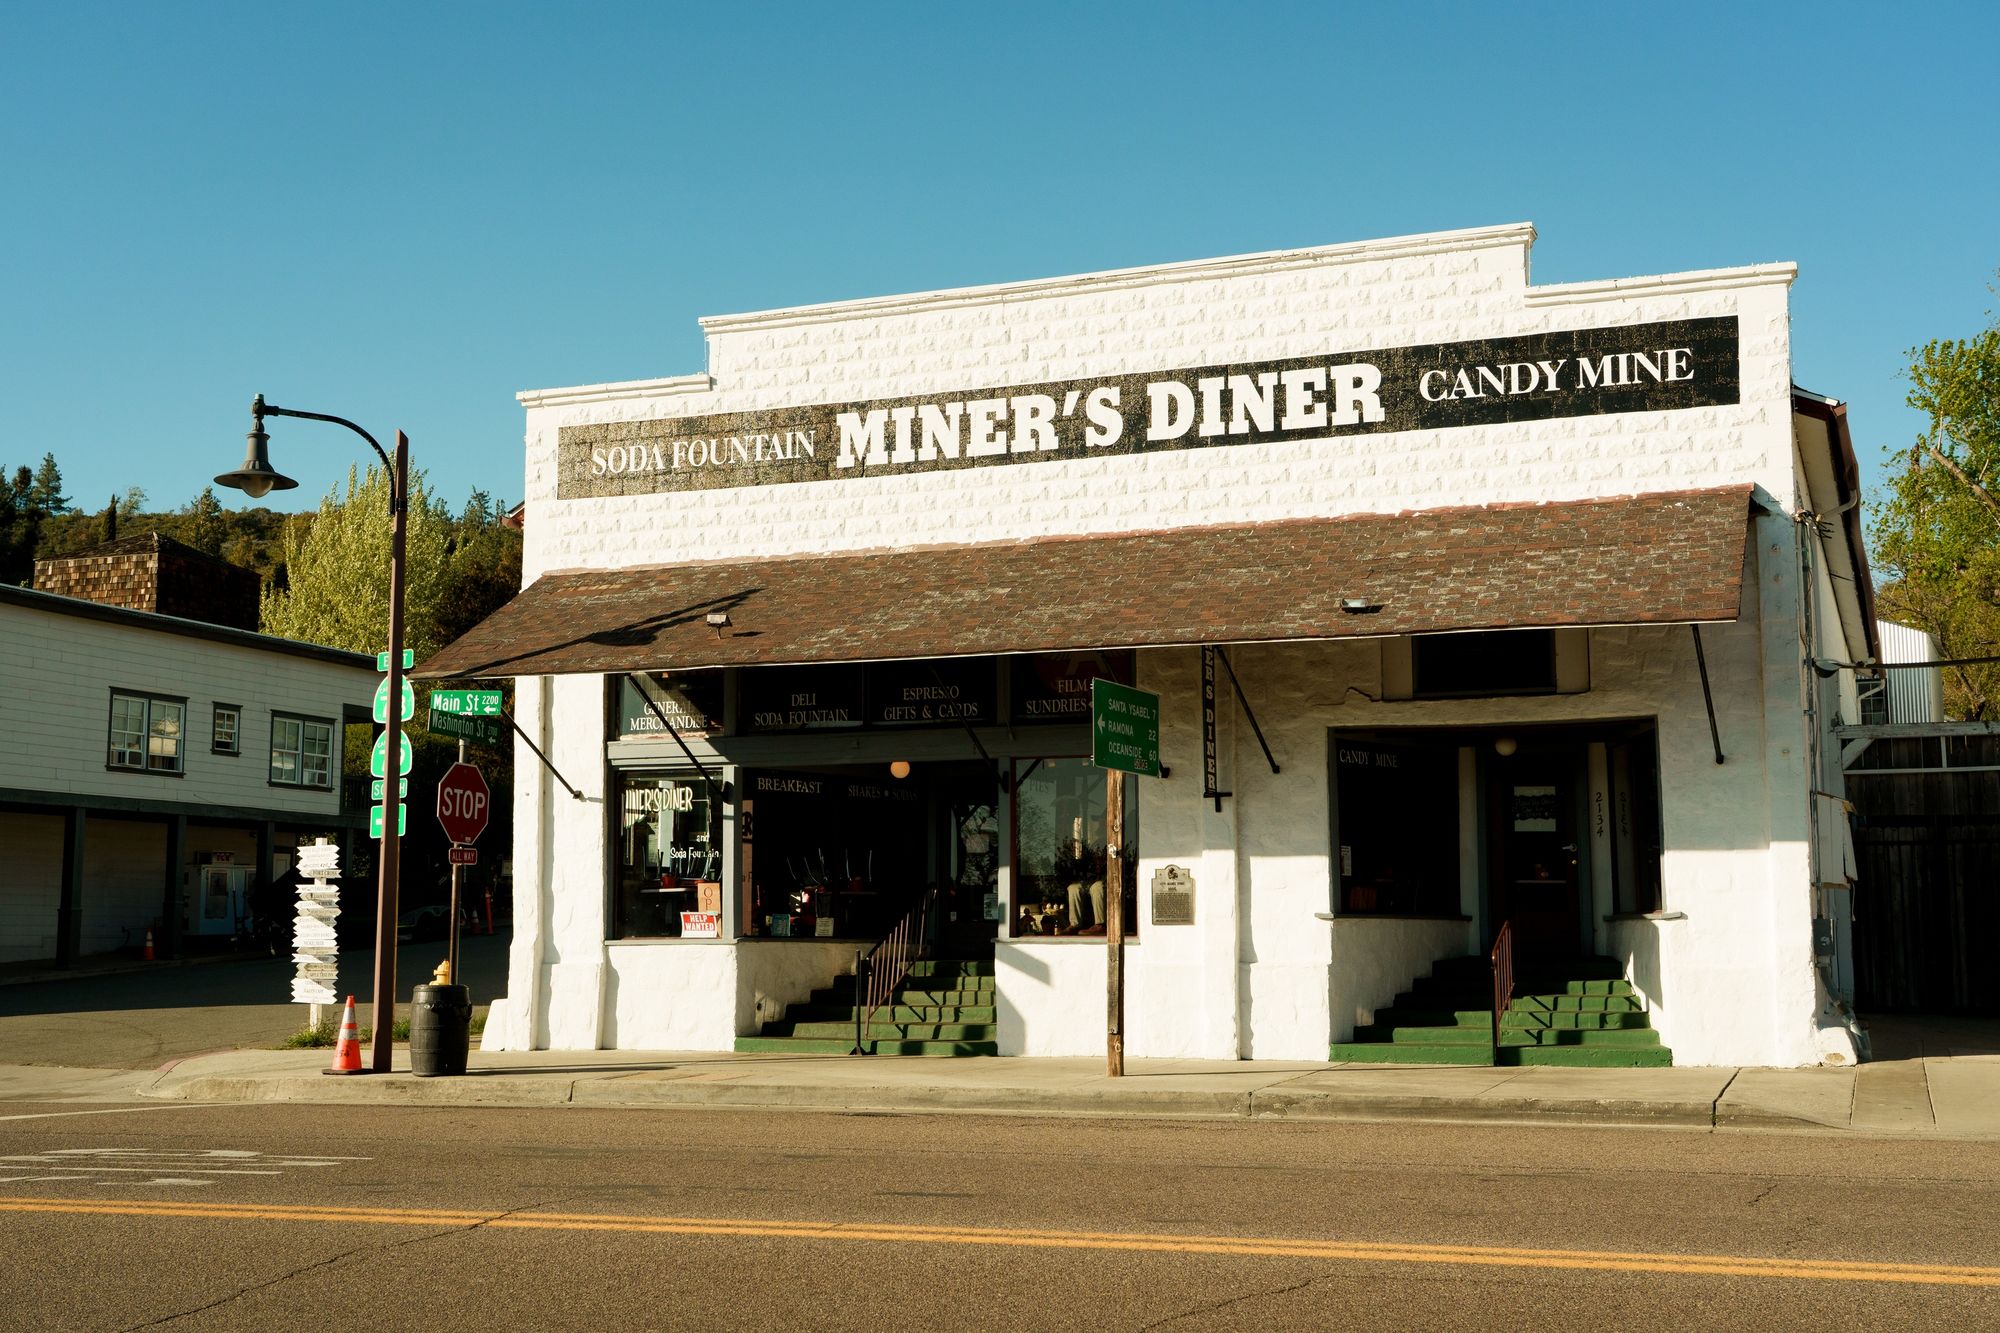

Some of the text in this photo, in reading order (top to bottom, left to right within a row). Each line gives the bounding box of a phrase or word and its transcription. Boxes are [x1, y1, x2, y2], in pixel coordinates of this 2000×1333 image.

[1419, 348, 1695, 402] CANDY MINE
[836, 363, 1386, 469] MINER'S DINER
[591, 430, 816, 476] SODA FOUNTAIN
[383, 653, 408, 667] ET
[902, 685, 960, 701] ESPRESO
[1057, 679, 1089, 693] FILM
[433, 693, 499, 712] Main St 2200
[643, 700, 692, 716] GNERAL
[790, 692, 817, 707] DELI
[1025, 698, 1088, 715] SUNDRIES
[754, 708, 849, 727] SODA FOUNTAIN
[884, 706, 917, 721] GIFTS
[921, 705, 934, 719] &
[1108, 698, 1157, 721] SANTA YSABEL 7
[432, 710, 474, 738] Washington
[476, 719, 485, 738] St
[1108, 719, 1157, 742] RAMONA 22
[1108, 742, 1157, 762] OCEANSIDE 60
[1206, 708, 1216, 790] DINER
[1339, 748, 1399, 769] CANDY MINE
[757, 777, 824, 795] BREAKFAST
[442, 787, 486, 820] STOP
[662, 786, 694, 812] DINER
[1595, 791, 1604, 838] 2134
[452, 851, 475, 862] ALL WAY
[670, 846, 720, 860] Soda Fouain
[685, 922, 714, 931] WANTED
[689, 914, 708, 923] HELP
